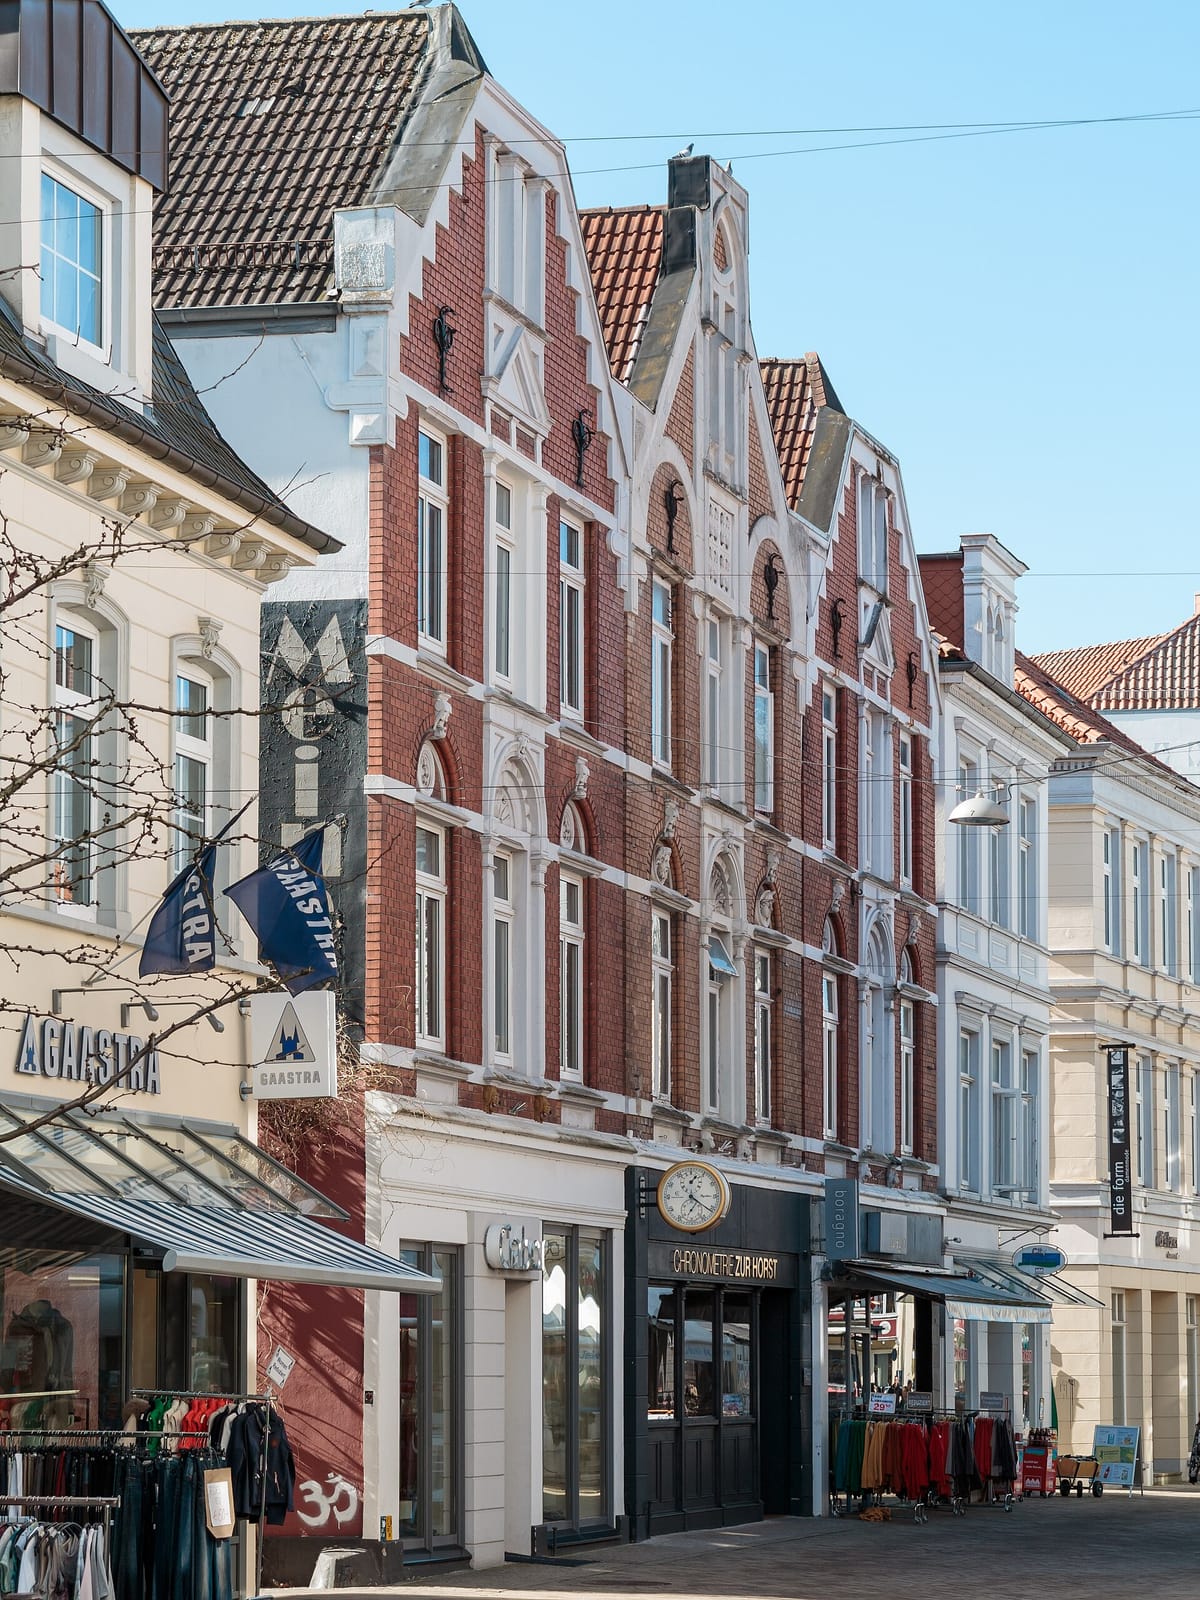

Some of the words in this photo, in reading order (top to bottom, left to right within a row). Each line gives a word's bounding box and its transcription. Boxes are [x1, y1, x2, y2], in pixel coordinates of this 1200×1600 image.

[42, 1018, 160, 1094] GAASTRA
[260, 1071, 320, 1086] GAASTRA
[1112, 1161, 1125, 1190] form
[832, 1190, 848, 1248] boragno
[1112, 1195, 1125, 1215] die
[673, 1249, 734, 1276] CHRONOMETRIE
[735, 1255, 751, 1278] ZUR
[752, 1257, 778, 1279] HORST
